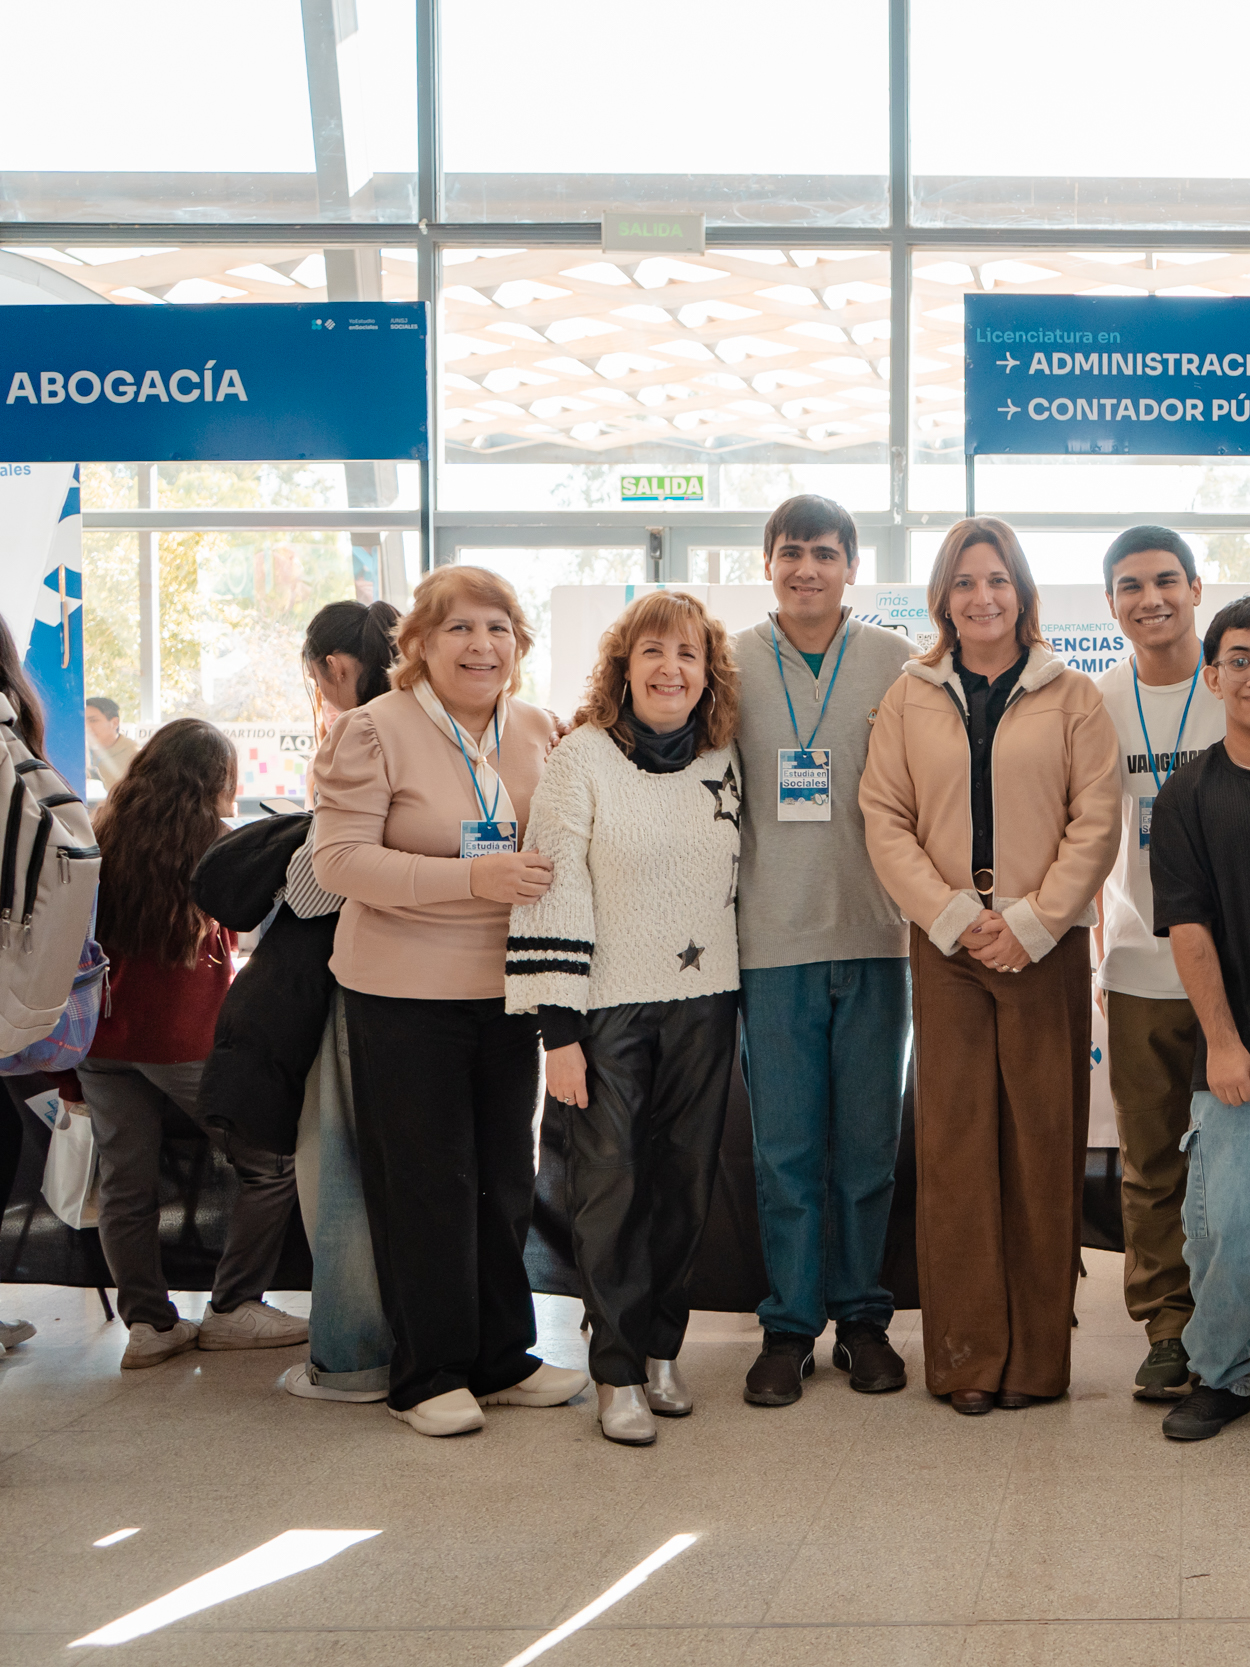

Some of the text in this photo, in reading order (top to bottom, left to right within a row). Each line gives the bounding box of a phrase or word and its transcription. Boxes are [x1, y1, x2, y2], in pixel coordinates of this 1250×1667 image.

[619, 222, 683, 237] SALIDA
[976, 327, 1121, 344] Licenciatura en
[6, 360, 248, 405] ABOGACÍA
[1027, 397, 1205, 422] CONTADOR
[622, 476, 703, 496] SALIDA
[879, 593, 909, 606] más
[1040, 623, 1115, 632] DEPARTAMENTO
[1045, 636, 1124, 652] ENCIAS
[783, 779, 827, 788] Sociales
[465, 842, 500, 850] Estudiá
